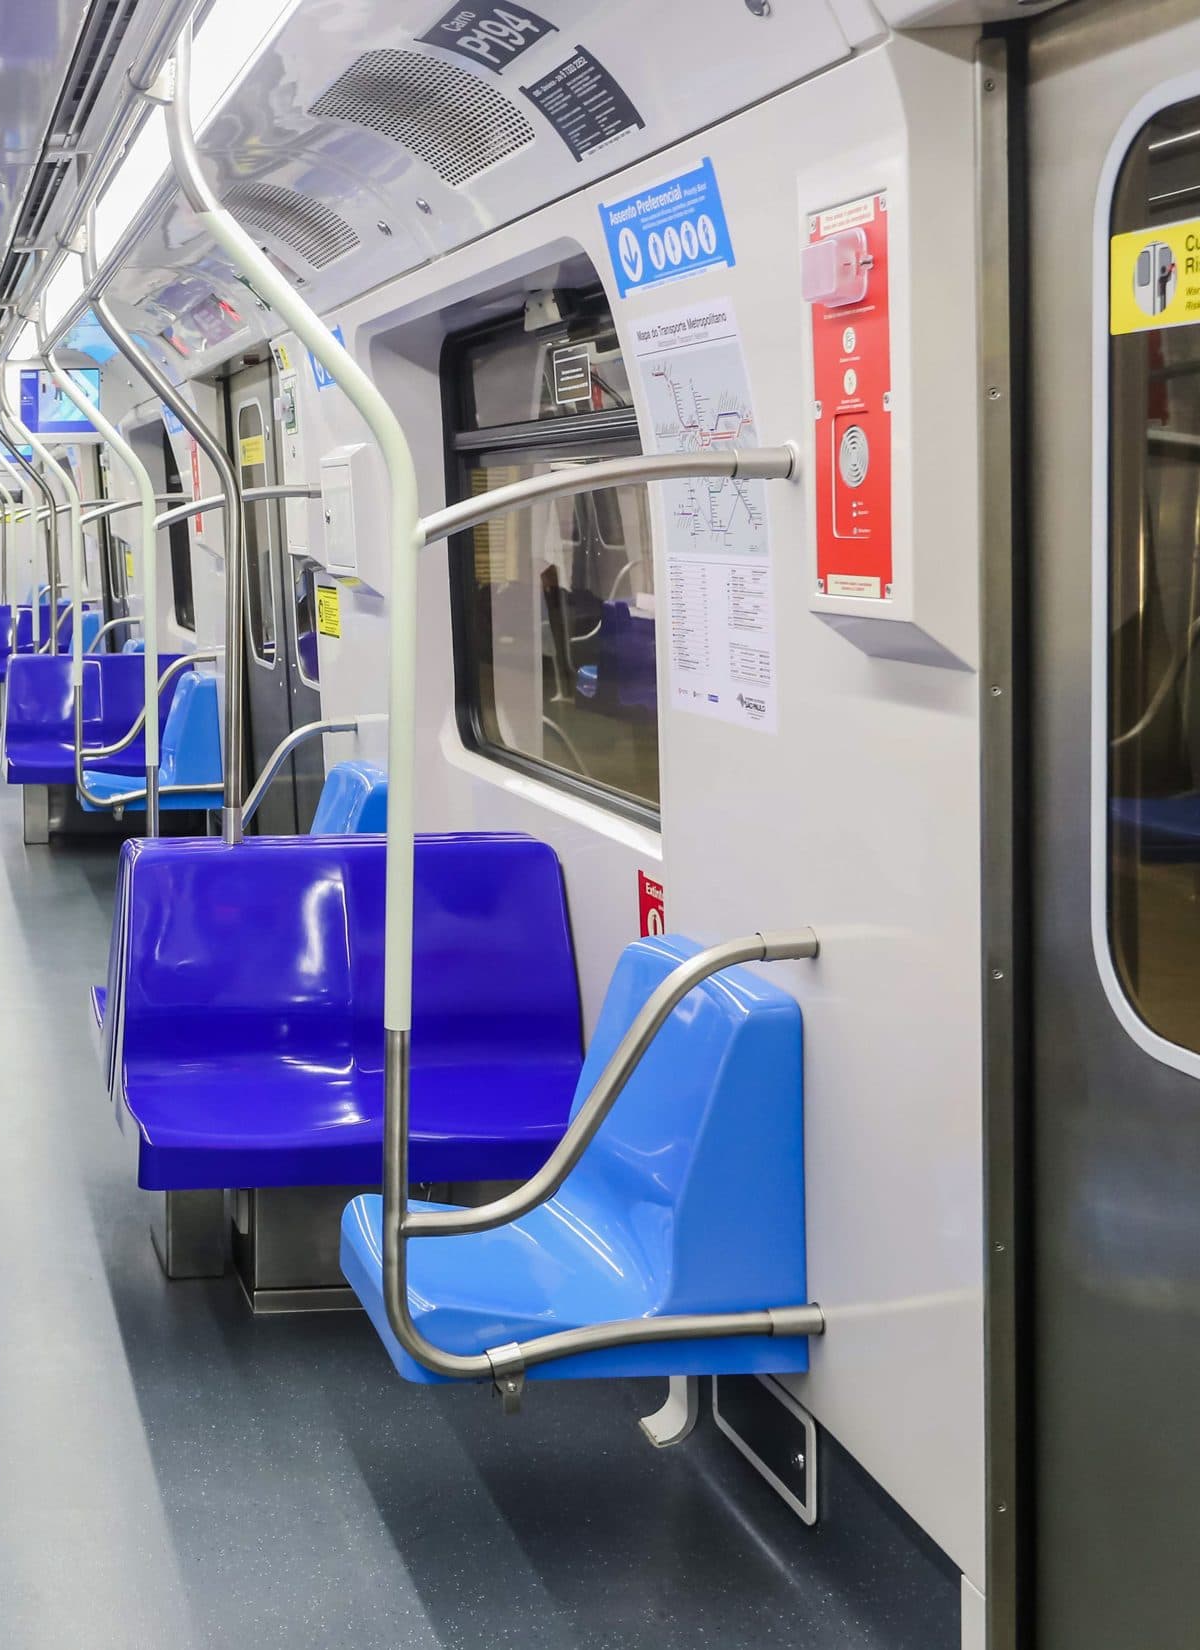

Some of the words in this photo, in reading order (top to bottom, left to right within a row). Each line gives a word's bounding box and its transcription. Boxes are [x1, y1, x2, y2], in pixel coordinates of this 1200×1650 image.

[441, 11, 476, 32] Carro
[456, 8, 540, 64] P194
[609, 204, 637, 226] Assento
[636, 184, 682, 215] Preferencial
[1185, 256, 1200, 275] Ri
[636, 330, 651, 342] Mapa
[651, 329, 659, 338] do
[658, 321, 687, 336] Transporte
[686, 312, 727, 330] Metropolitano
